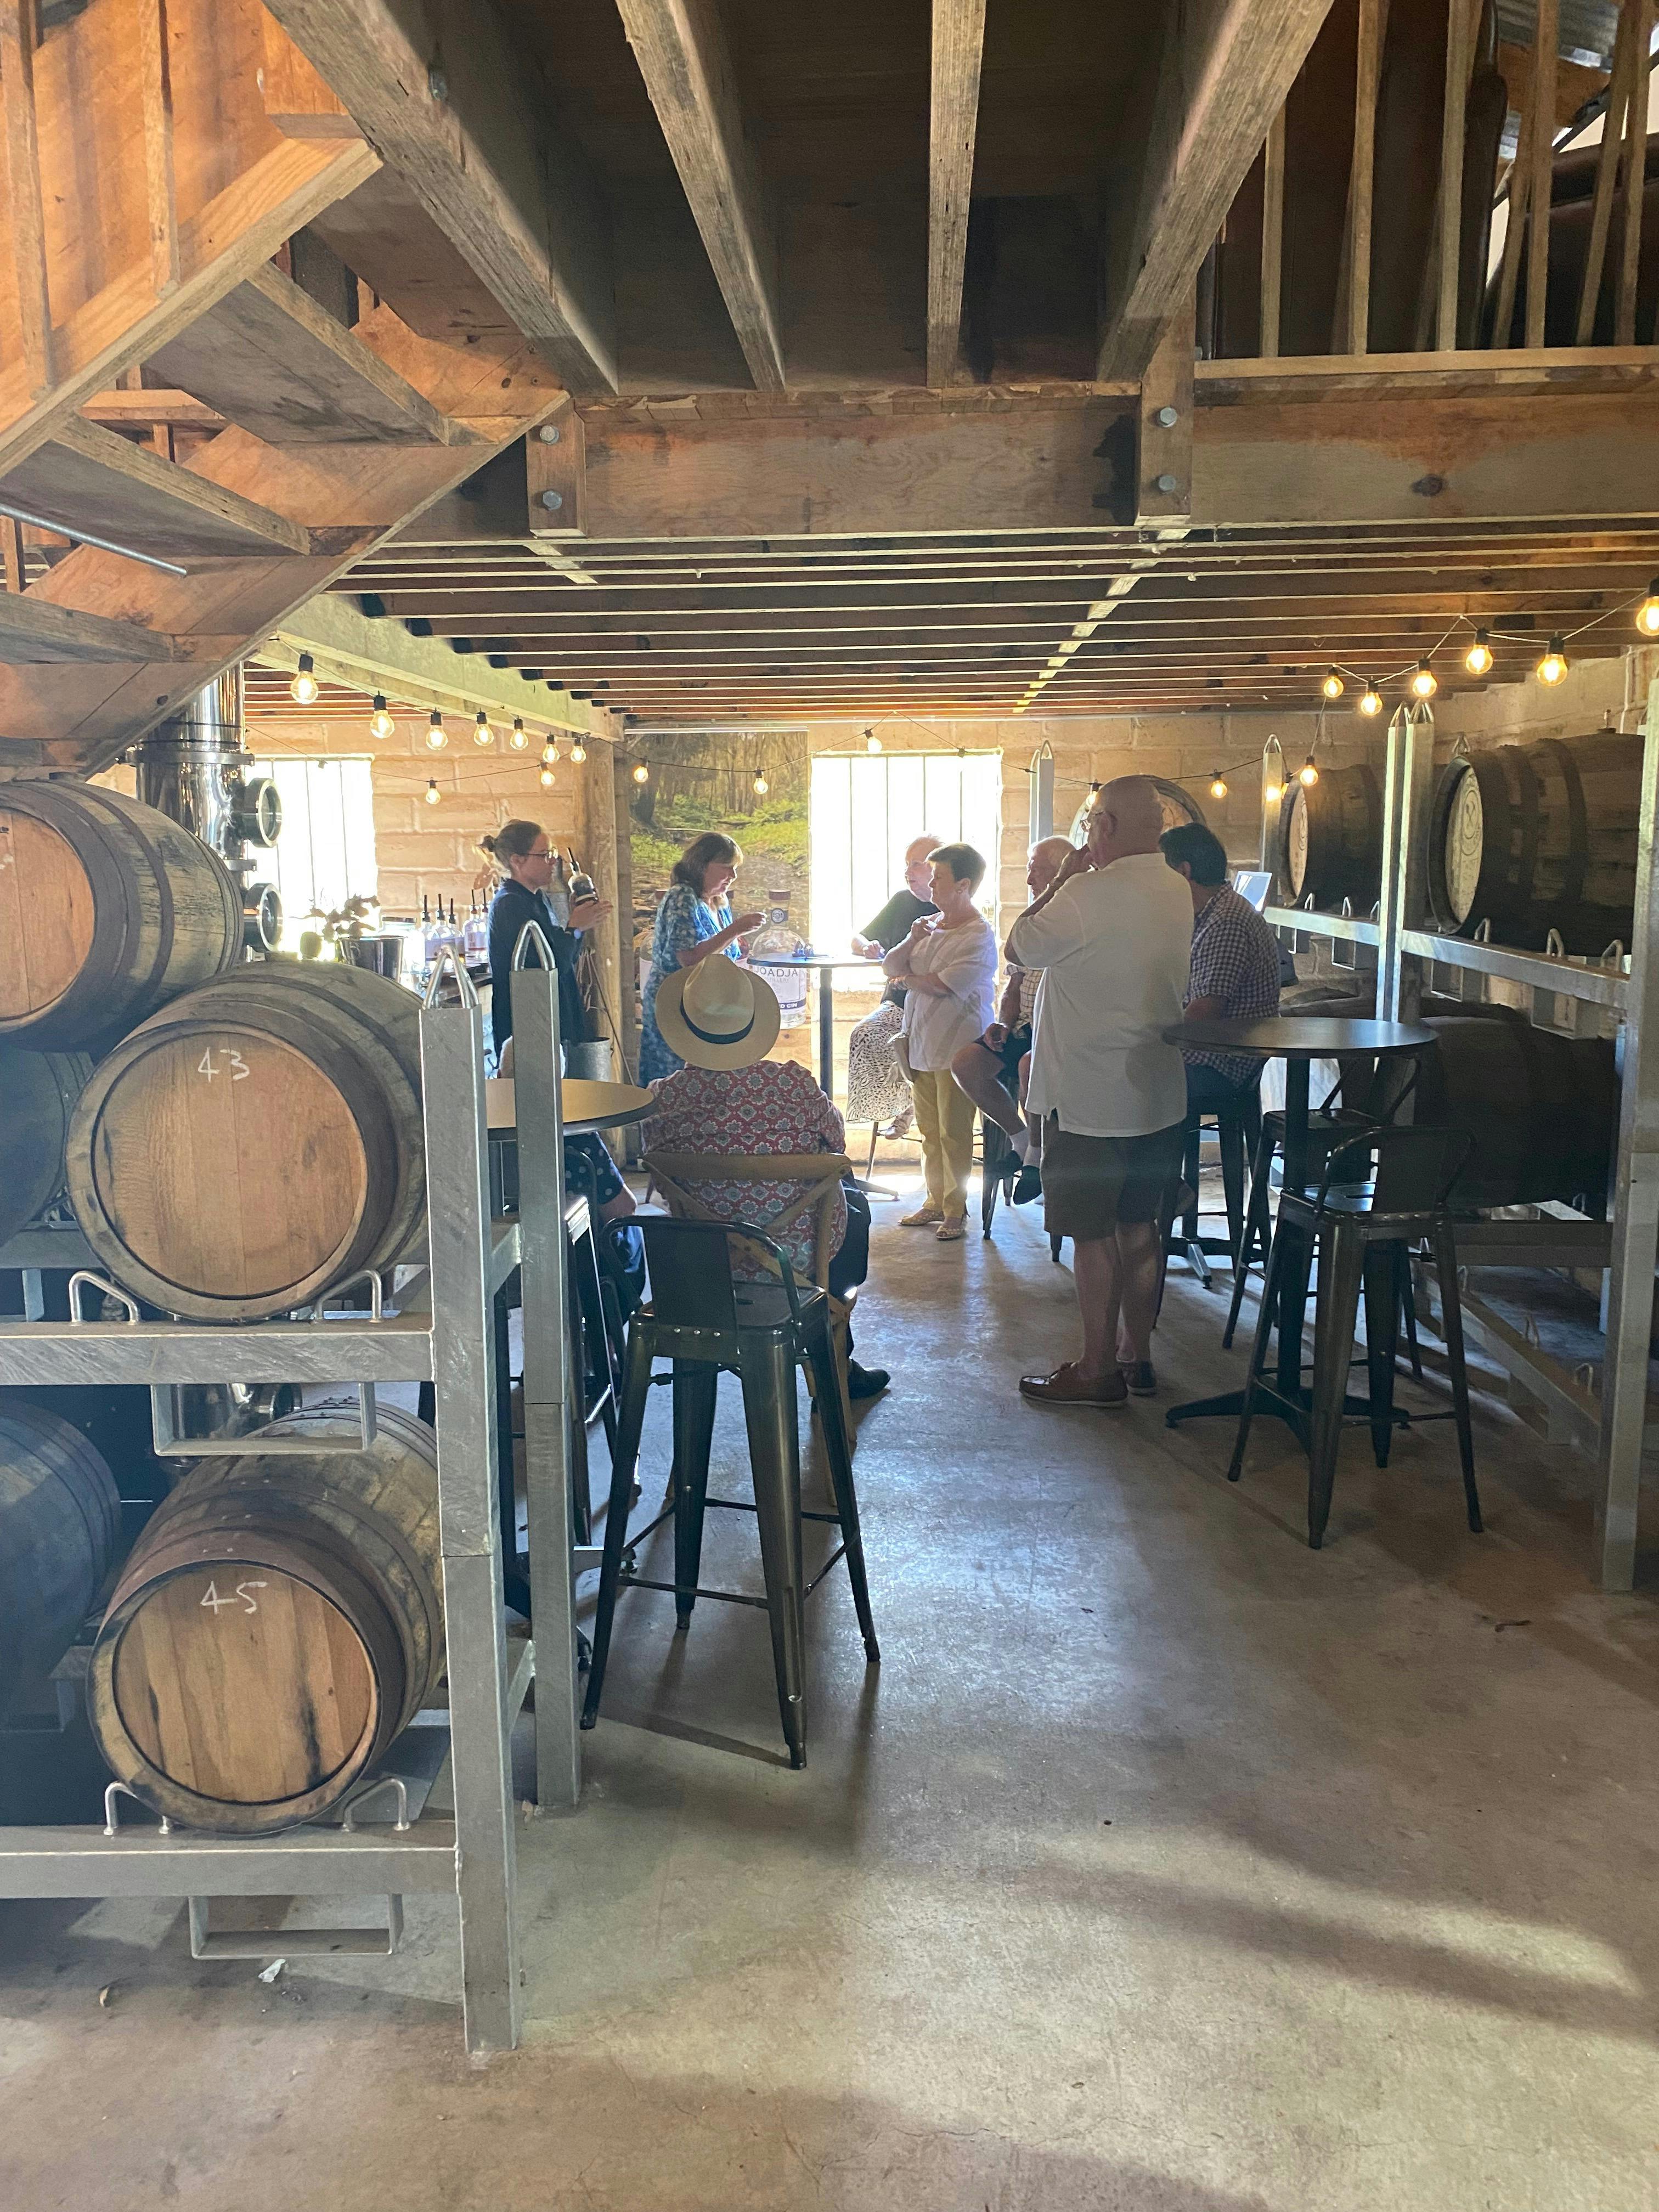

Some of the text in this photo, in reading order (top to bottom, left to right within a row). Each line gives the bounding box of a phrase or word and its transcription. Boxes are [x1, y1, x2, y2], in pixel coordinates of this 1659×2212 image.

[755, 966, 798, 977] JOADJA
[198, 1046, 250, 1083] 43
[200, 1581, 268, 1615] 45
